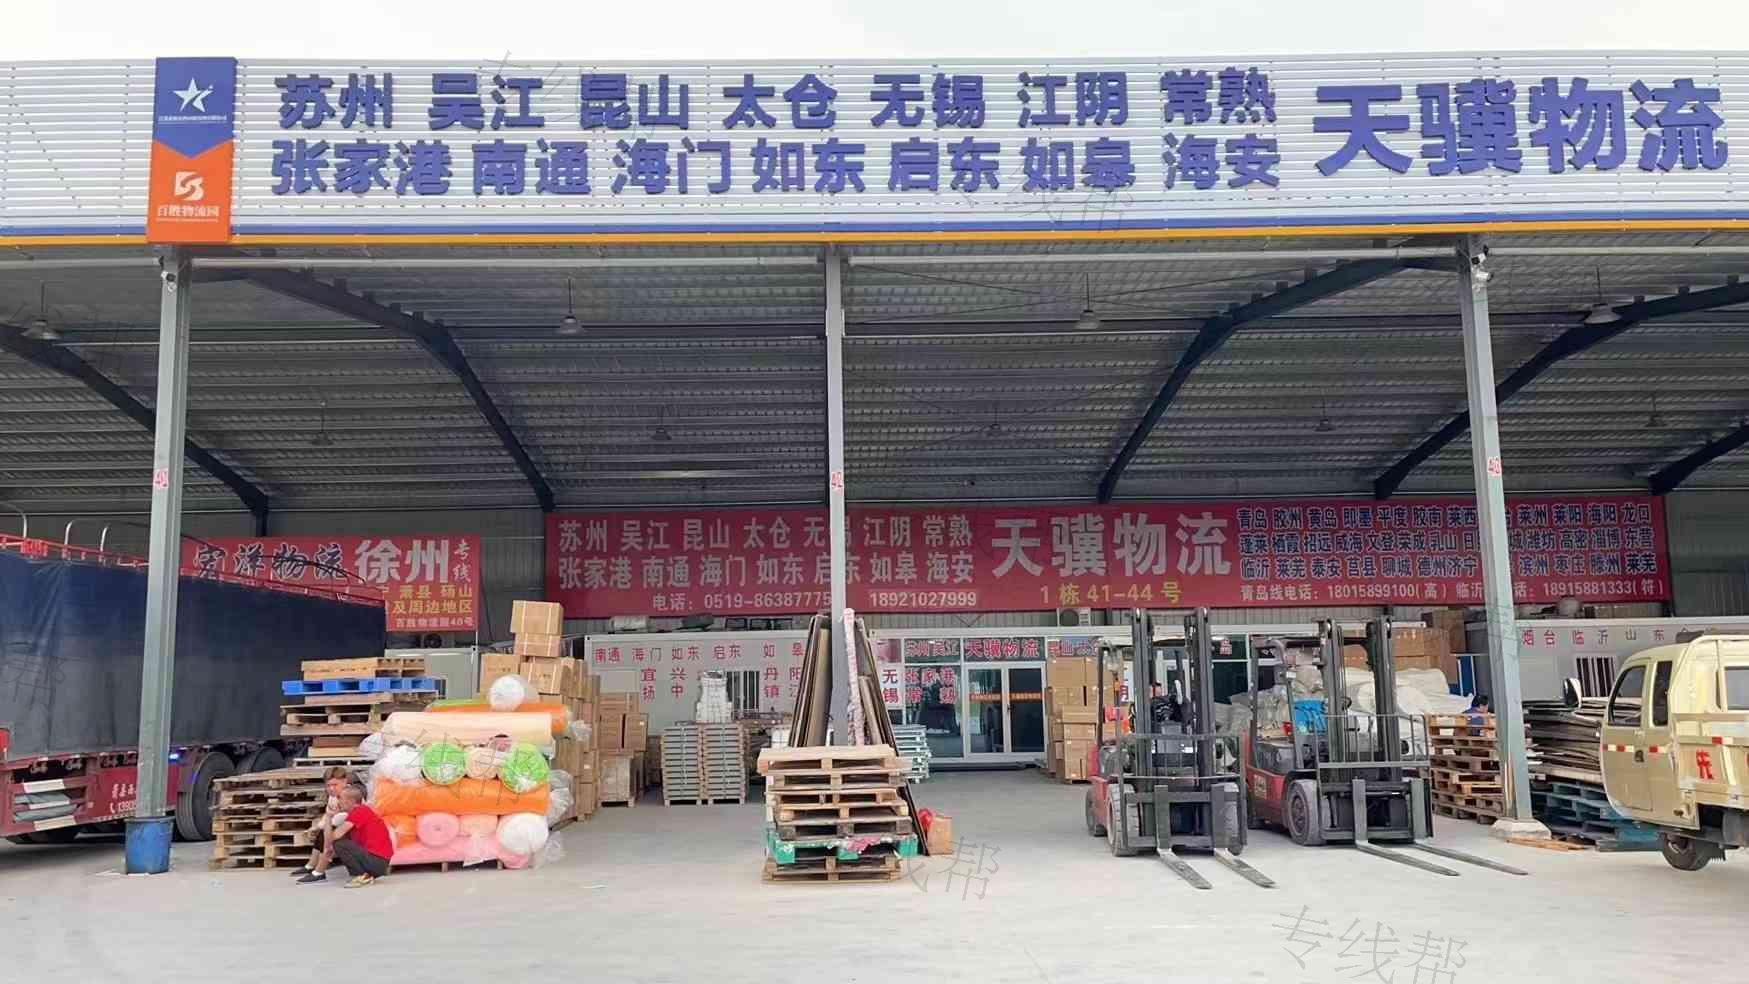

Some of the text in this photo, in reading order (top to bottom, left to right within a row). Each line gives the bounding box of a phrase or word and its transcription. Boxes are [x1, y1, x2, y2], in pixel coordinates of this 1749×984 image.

[278, 72, 393, 130] 苏州
[428, 72, 546, 130] 吴江
[579, 72, 690, 130] 昆山
[723, 72, 839, 130] 太仓
[871, 72, 987, 129] 无锡
[1018, 70, 1129, 129] 江阴
[1160, 65, 1277, 125] 常熟
[272, 138, 453, 196] 张家港
[472, 138, 593, 195] 南通
[611, 138, 733, 194] 海门
[751, 136, 866, 194] 如东
[888, 136, 1001, 194] 启东
[1022, 136, 1136, 191] 如皋
[1163, 133, 1281, 190] 海安
[1238, 506, 1268, 530] 青岛
[1272, 506, 1303, 530] 胶州
[1308, 506, 1338, 530] 黄岛
[1342, 505, 1372, 529] 即墨
[1377, 505, 1408, 529] 平度
[1412, 505, 1442, 529] 胶南
[1447, 505, 1477, 528] 莱西
[1518, 504, 1548, 526] 莱州
[1553, 503, 1582, 526] 莱阳
[1588, 503, 1617, 526] 海阳
[558, 519, 609, 553] 苏州
[620, 520, 672, 552] 吴江
[682, 518, 731, 551] 昆山
[742, 516, 792, 549] 太仓
[863, 515, 912, 547] 江阴
[922, 514, 973, 547] 常熟
[1303, 531, 1332, 554] 招远
[1367, 530, 1396, 553] 文登
[1398, 530, 1427, 553] 荣成
[1429, 529, 1458, 553] 乳山
[1560, 527, 1589, 550] 高密
[1624, 526, 1654, 549] 东营
[354, 538, 449, 584] 徐州
[453, 539, 472, 583] 专线
[558, 555, 632, 589] 张家港
[641, 556, 691, 589] 南通
[699, 554, 747, 587] 海门
[756, 553, 805, 585] 如东
[870, 551, 917, 585] 如皋
[926, 550, 975, 584] 海安
[1241, 557, 1270, 579] 临沂
[1276, 557, 1306, 579] 莱芜
[1311, 556, 1341, 578] 泰安
[1346, 556, 1377, 578] 莒县
[391, 599, 473, 615] 及周边地区
[869, 591, 977, 608] 18921027999
[1522, 629, 1556, 646] 烟台
[594, 647, 621, 663] 南通
[632, 645, 662, 662] 海门
[671, 644, 699, 661] 如东
[713, 644, 741, 660] 启东
[640, 667, 687, 682] 宜兴
